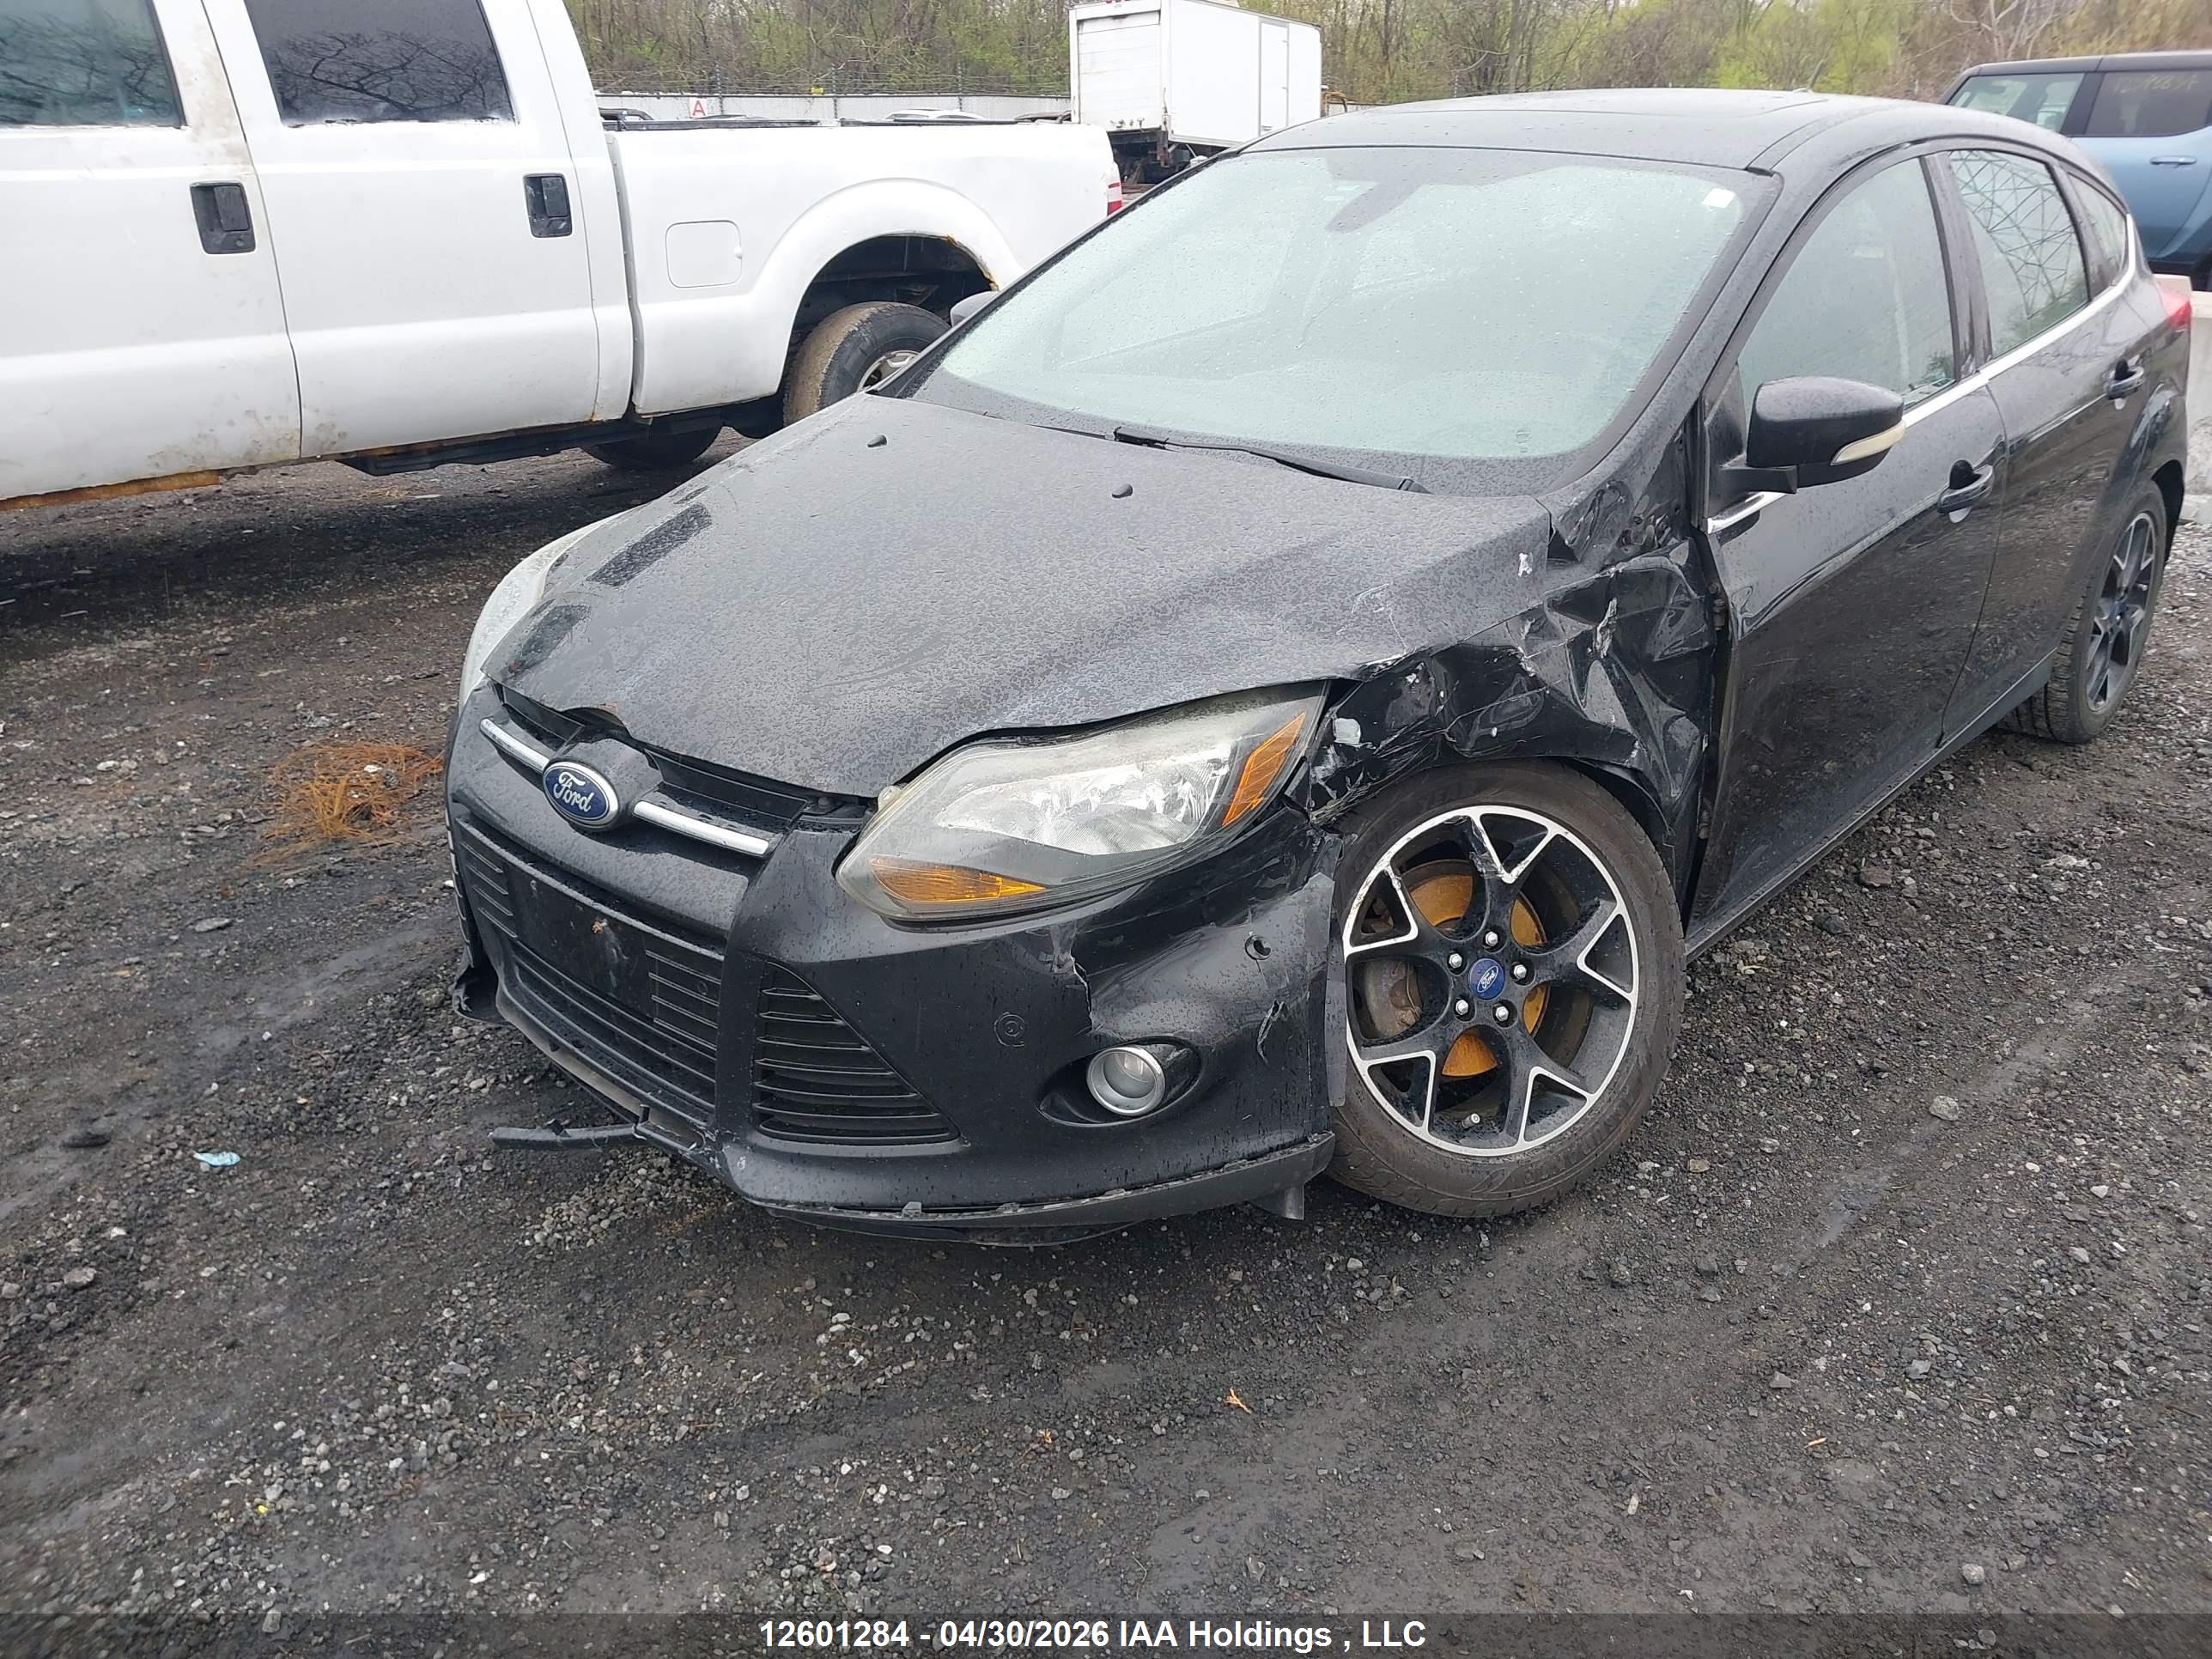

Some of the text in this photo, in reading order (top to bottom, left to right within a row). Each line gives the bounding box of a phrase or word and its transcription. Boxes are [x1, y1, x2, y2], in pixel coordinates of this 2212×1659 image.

[691, 100, 707, 117] A
[552, 771, 594, 813] Ford
[1480, 969, 1497, 989] Ford
